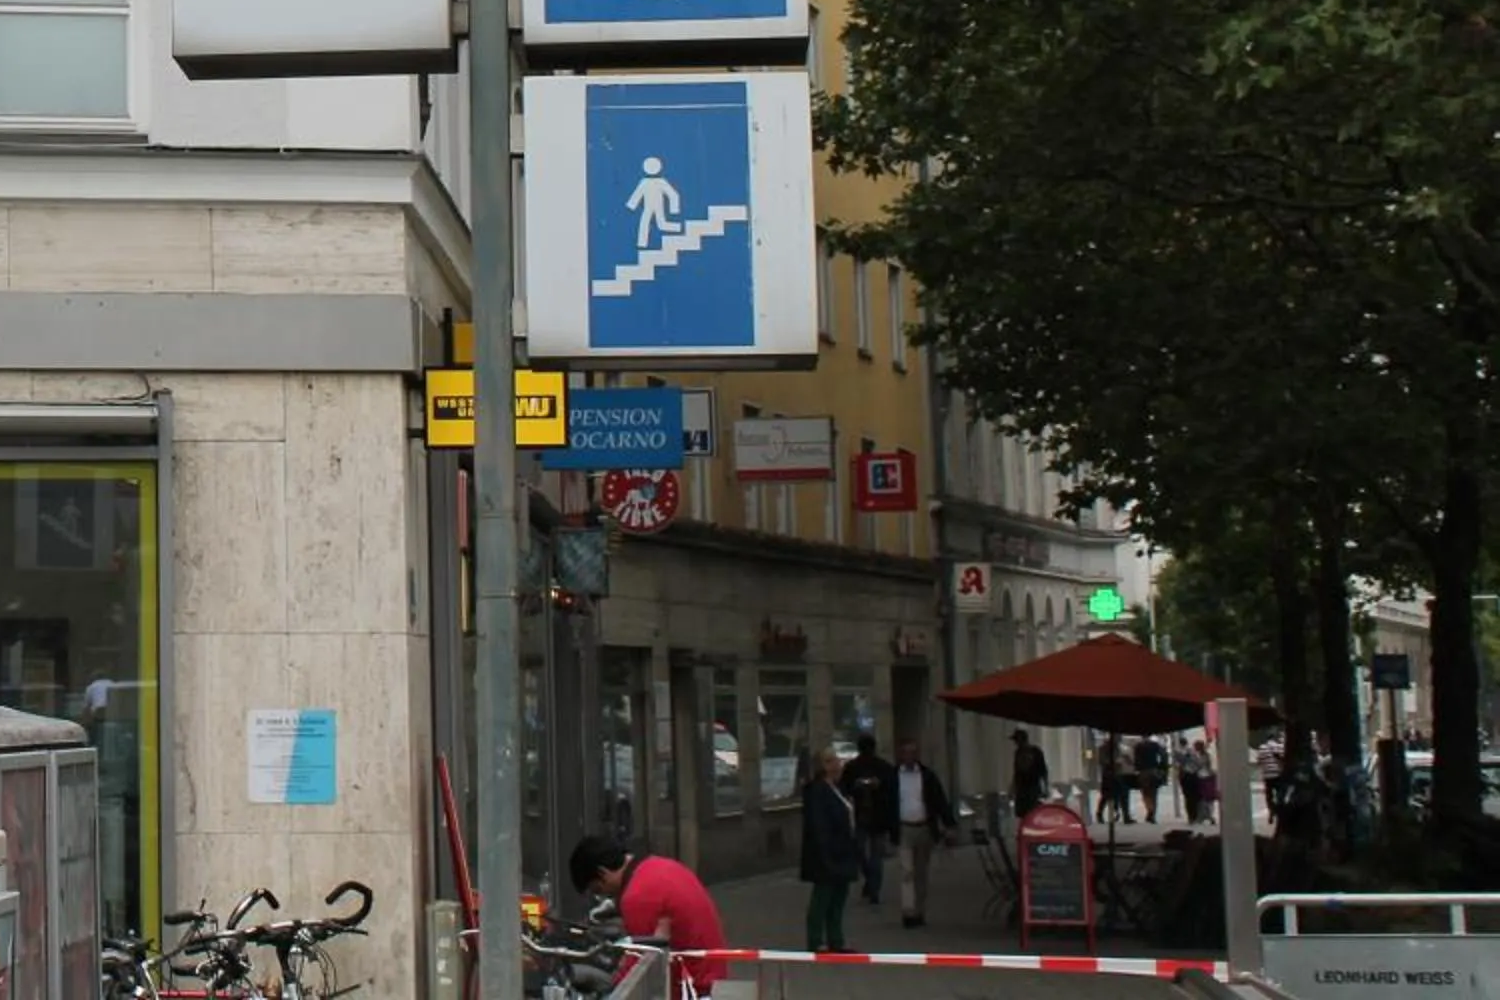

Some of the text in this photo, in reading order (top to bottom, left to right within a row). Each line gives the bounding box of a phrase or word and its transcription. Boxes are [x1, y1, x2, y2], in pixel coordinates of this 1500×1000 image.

[437, 399, 474, 409] WEST
[569, 407, 663, 427] PENSION
[570, 430, 667, 449] OCARNO
[612, 502, 667, 528] LIBRE
[1314, 969, 1455, 986] LEONHARD WEISS
